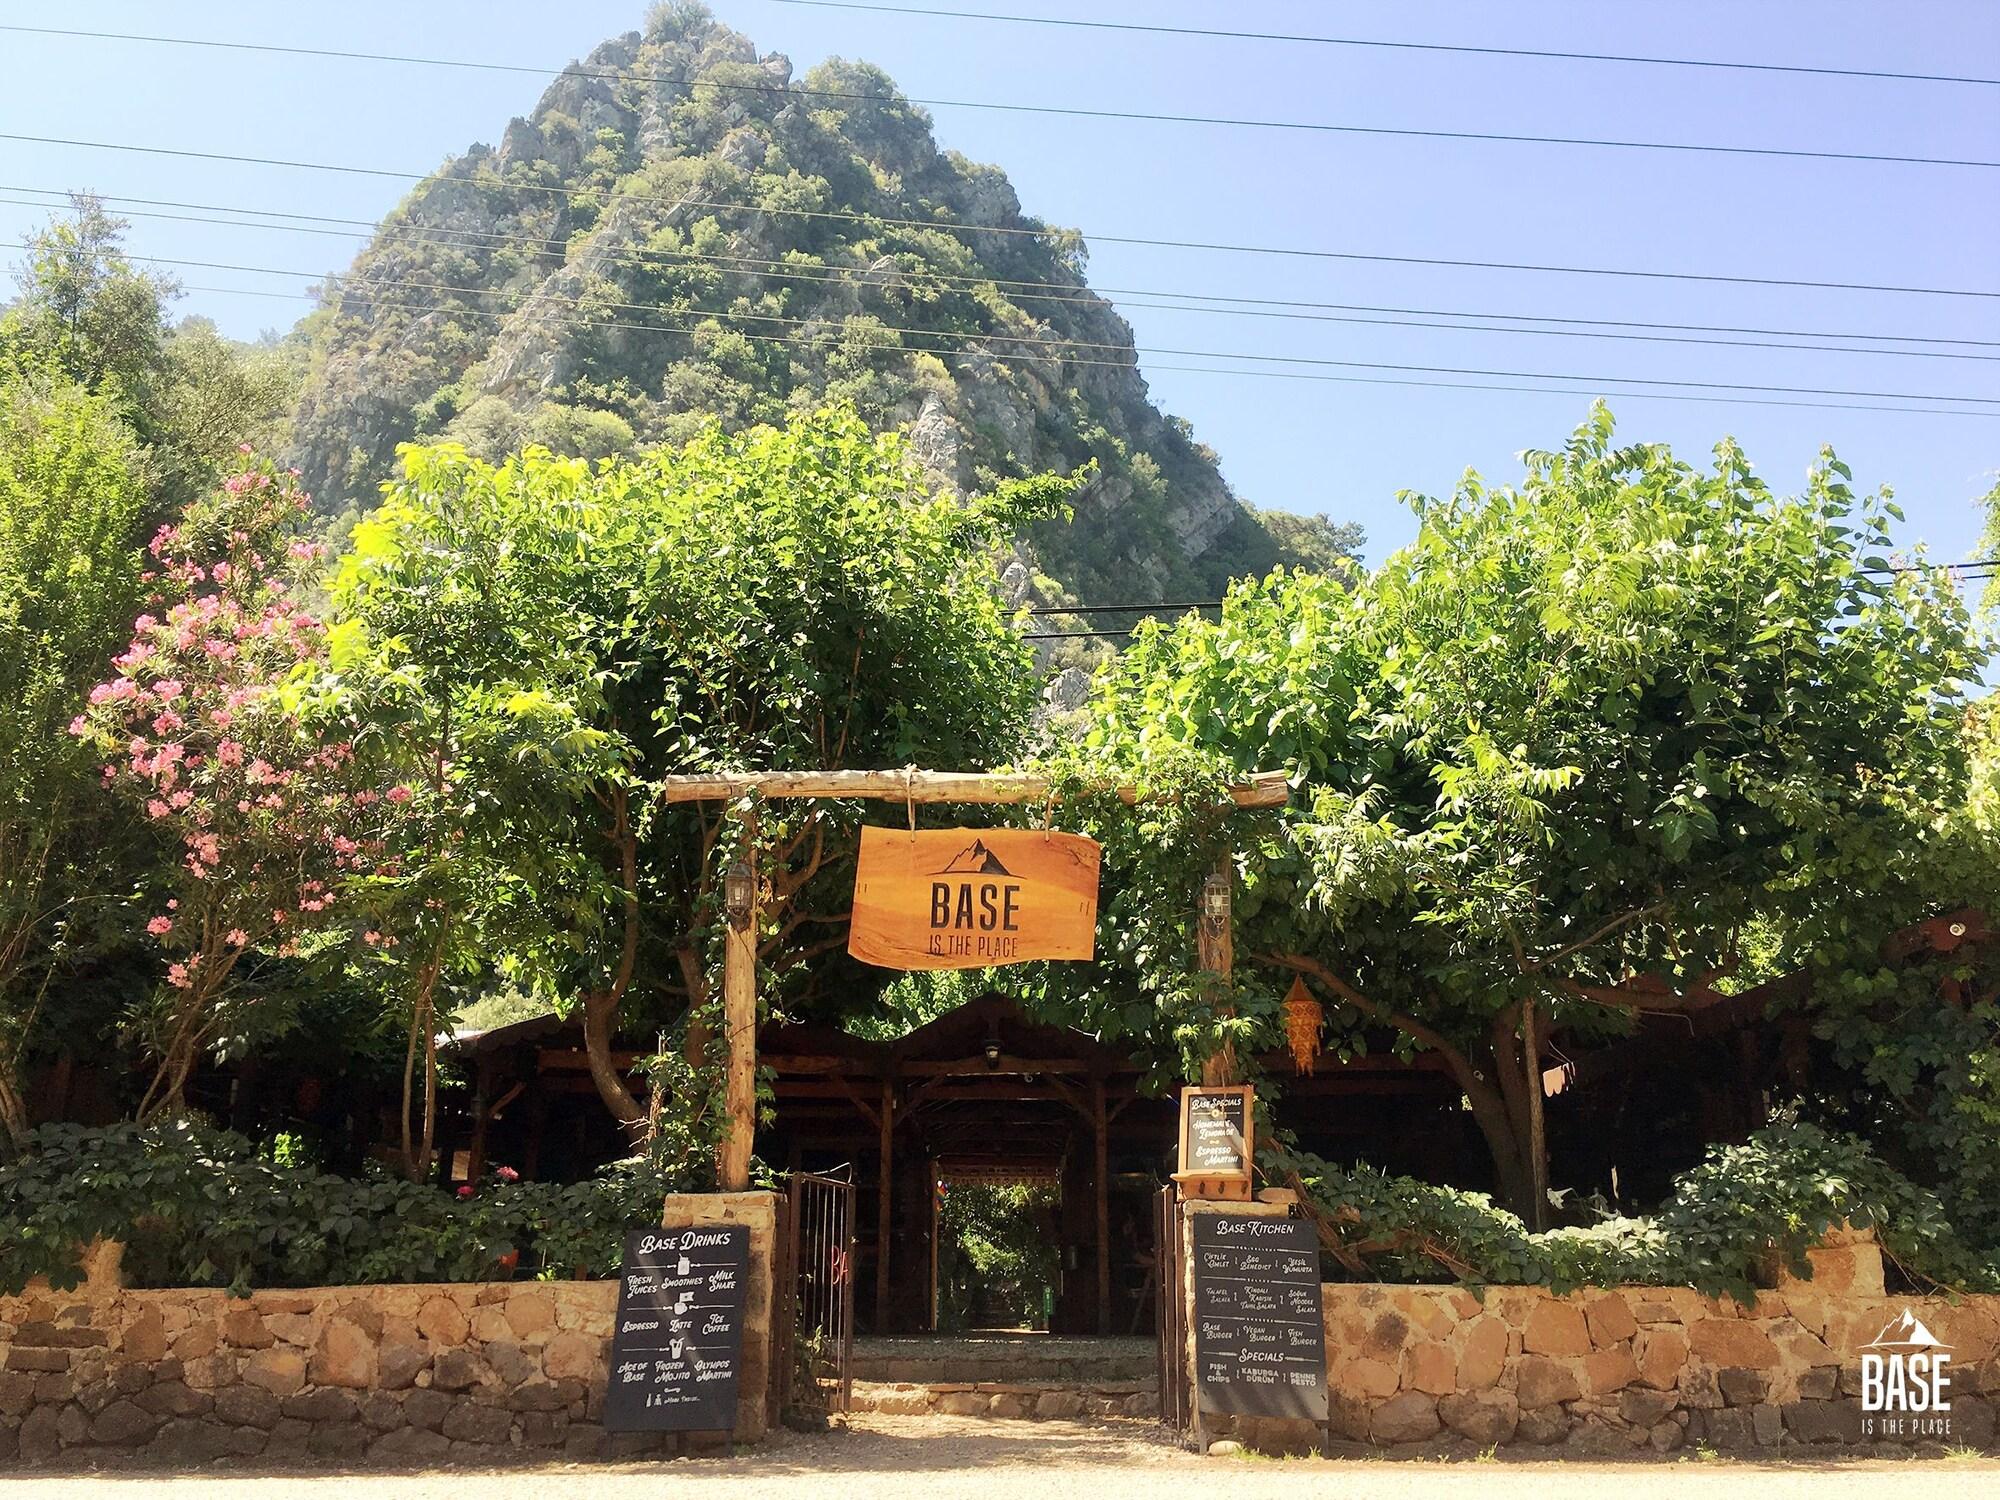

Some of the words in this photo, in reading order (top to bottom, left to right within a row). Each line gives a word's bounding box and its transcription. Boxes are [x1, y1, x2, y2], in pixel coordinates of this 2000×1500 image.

[930, 882, 1020, 931] BASE
[929, 934, 942, 954] IS
[948, 935, 971, 956] THE
[978, 937, 1017, 958] PLACE
[1192, 1100, 1210, 1110] BASE
[1195, 1146, 1231, 1157] ESPRESSO
[1204, 1155, 1238, 1166] MARTINI
[1216, 1220, 1246, 1235] BASE
[1247, 1221, 1295, 1237] KITCHEN
[638, 1235, 678, 1255] BASE
[679, 1231, 732, 1251] DRINKS
[627, 1274, 653, 1286] FRESH
[708, 1270, 735, 1282] MILK
[661, 1276, 704, 1290] SMOOTHIES
[708, 1281, 737, 1292] SHAKE
[627, 1284, 658, 1299] JUICES
[709, 1313, 725, 1324] ICE
[622, 1320, 659, 1333] ESPRESSO
[669, 1318, 693, 1333] LATTE
[702, 1323, 731, 1335] COFFEE
[1243, 1325, 1266, 1335] VEGAN
[1238, 1347, 1285, 1363] SPECIALS
[637, 1361, 649, 1370] OF
[654, 1360, 685, 1372] FROZEN
[622, 1372, 646, 1383] BASE
[654, 1371, 691, 1384] MOJITO
[696, 1370, 733, 1383] MARTINI
[1206, 1375, 1230, 1383] CHIPS
[1290, 1378, 1317, 1387] PESTO
